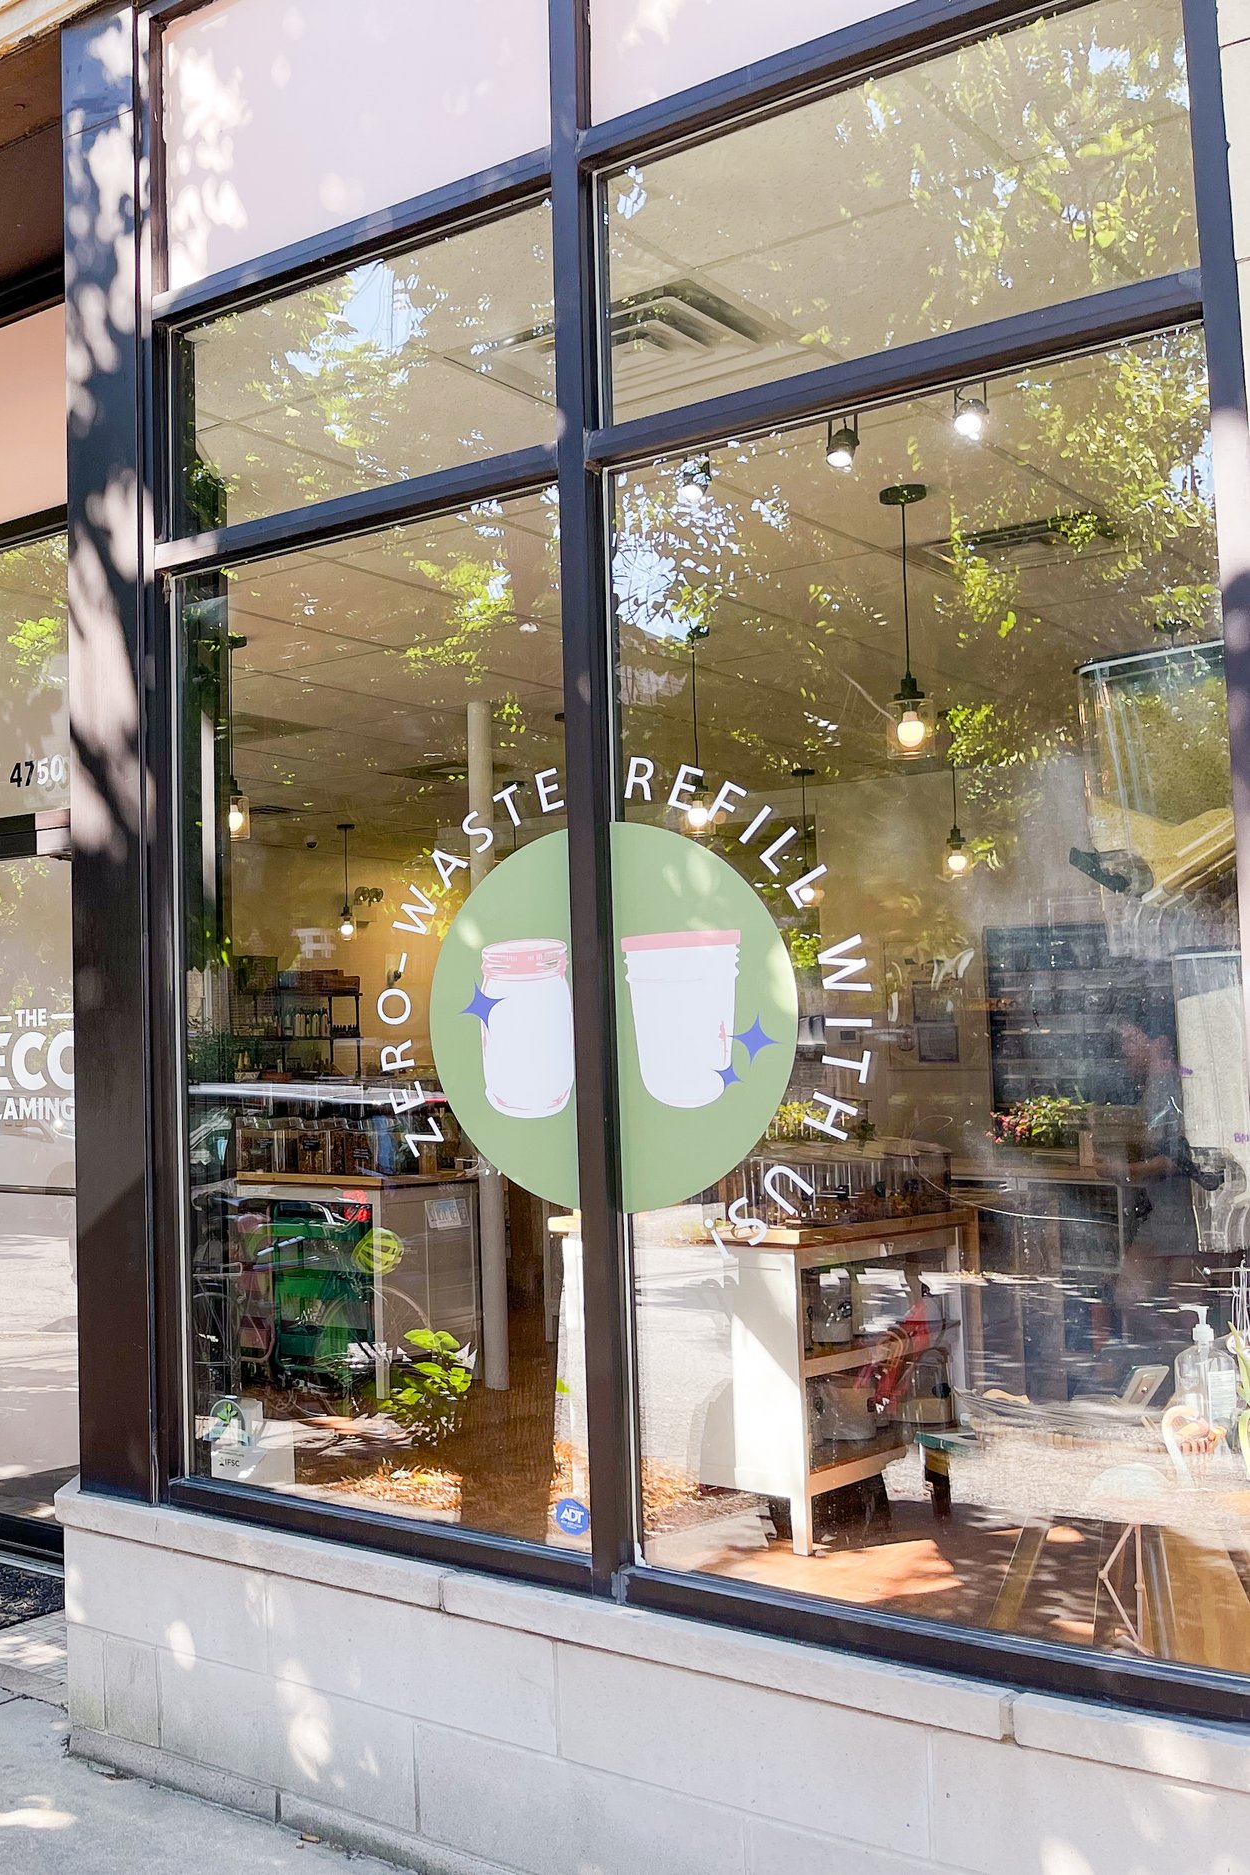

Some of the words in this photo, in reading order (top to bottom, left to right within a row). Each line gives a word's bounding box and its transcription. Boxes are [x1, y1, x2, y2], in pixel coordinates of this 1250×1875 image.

[9, 753, 64, 788] 4750
[378, 767, 565, 1158] ZERO-WASTE
[624, 756, 829, 910] REFILL
[802, 934, 873, 1141] WITH
[15, 1007, 48, 1028] THE
[224, 1458, 241, 1467] IFSC
[560, 1507, 584, 1524] ADT
